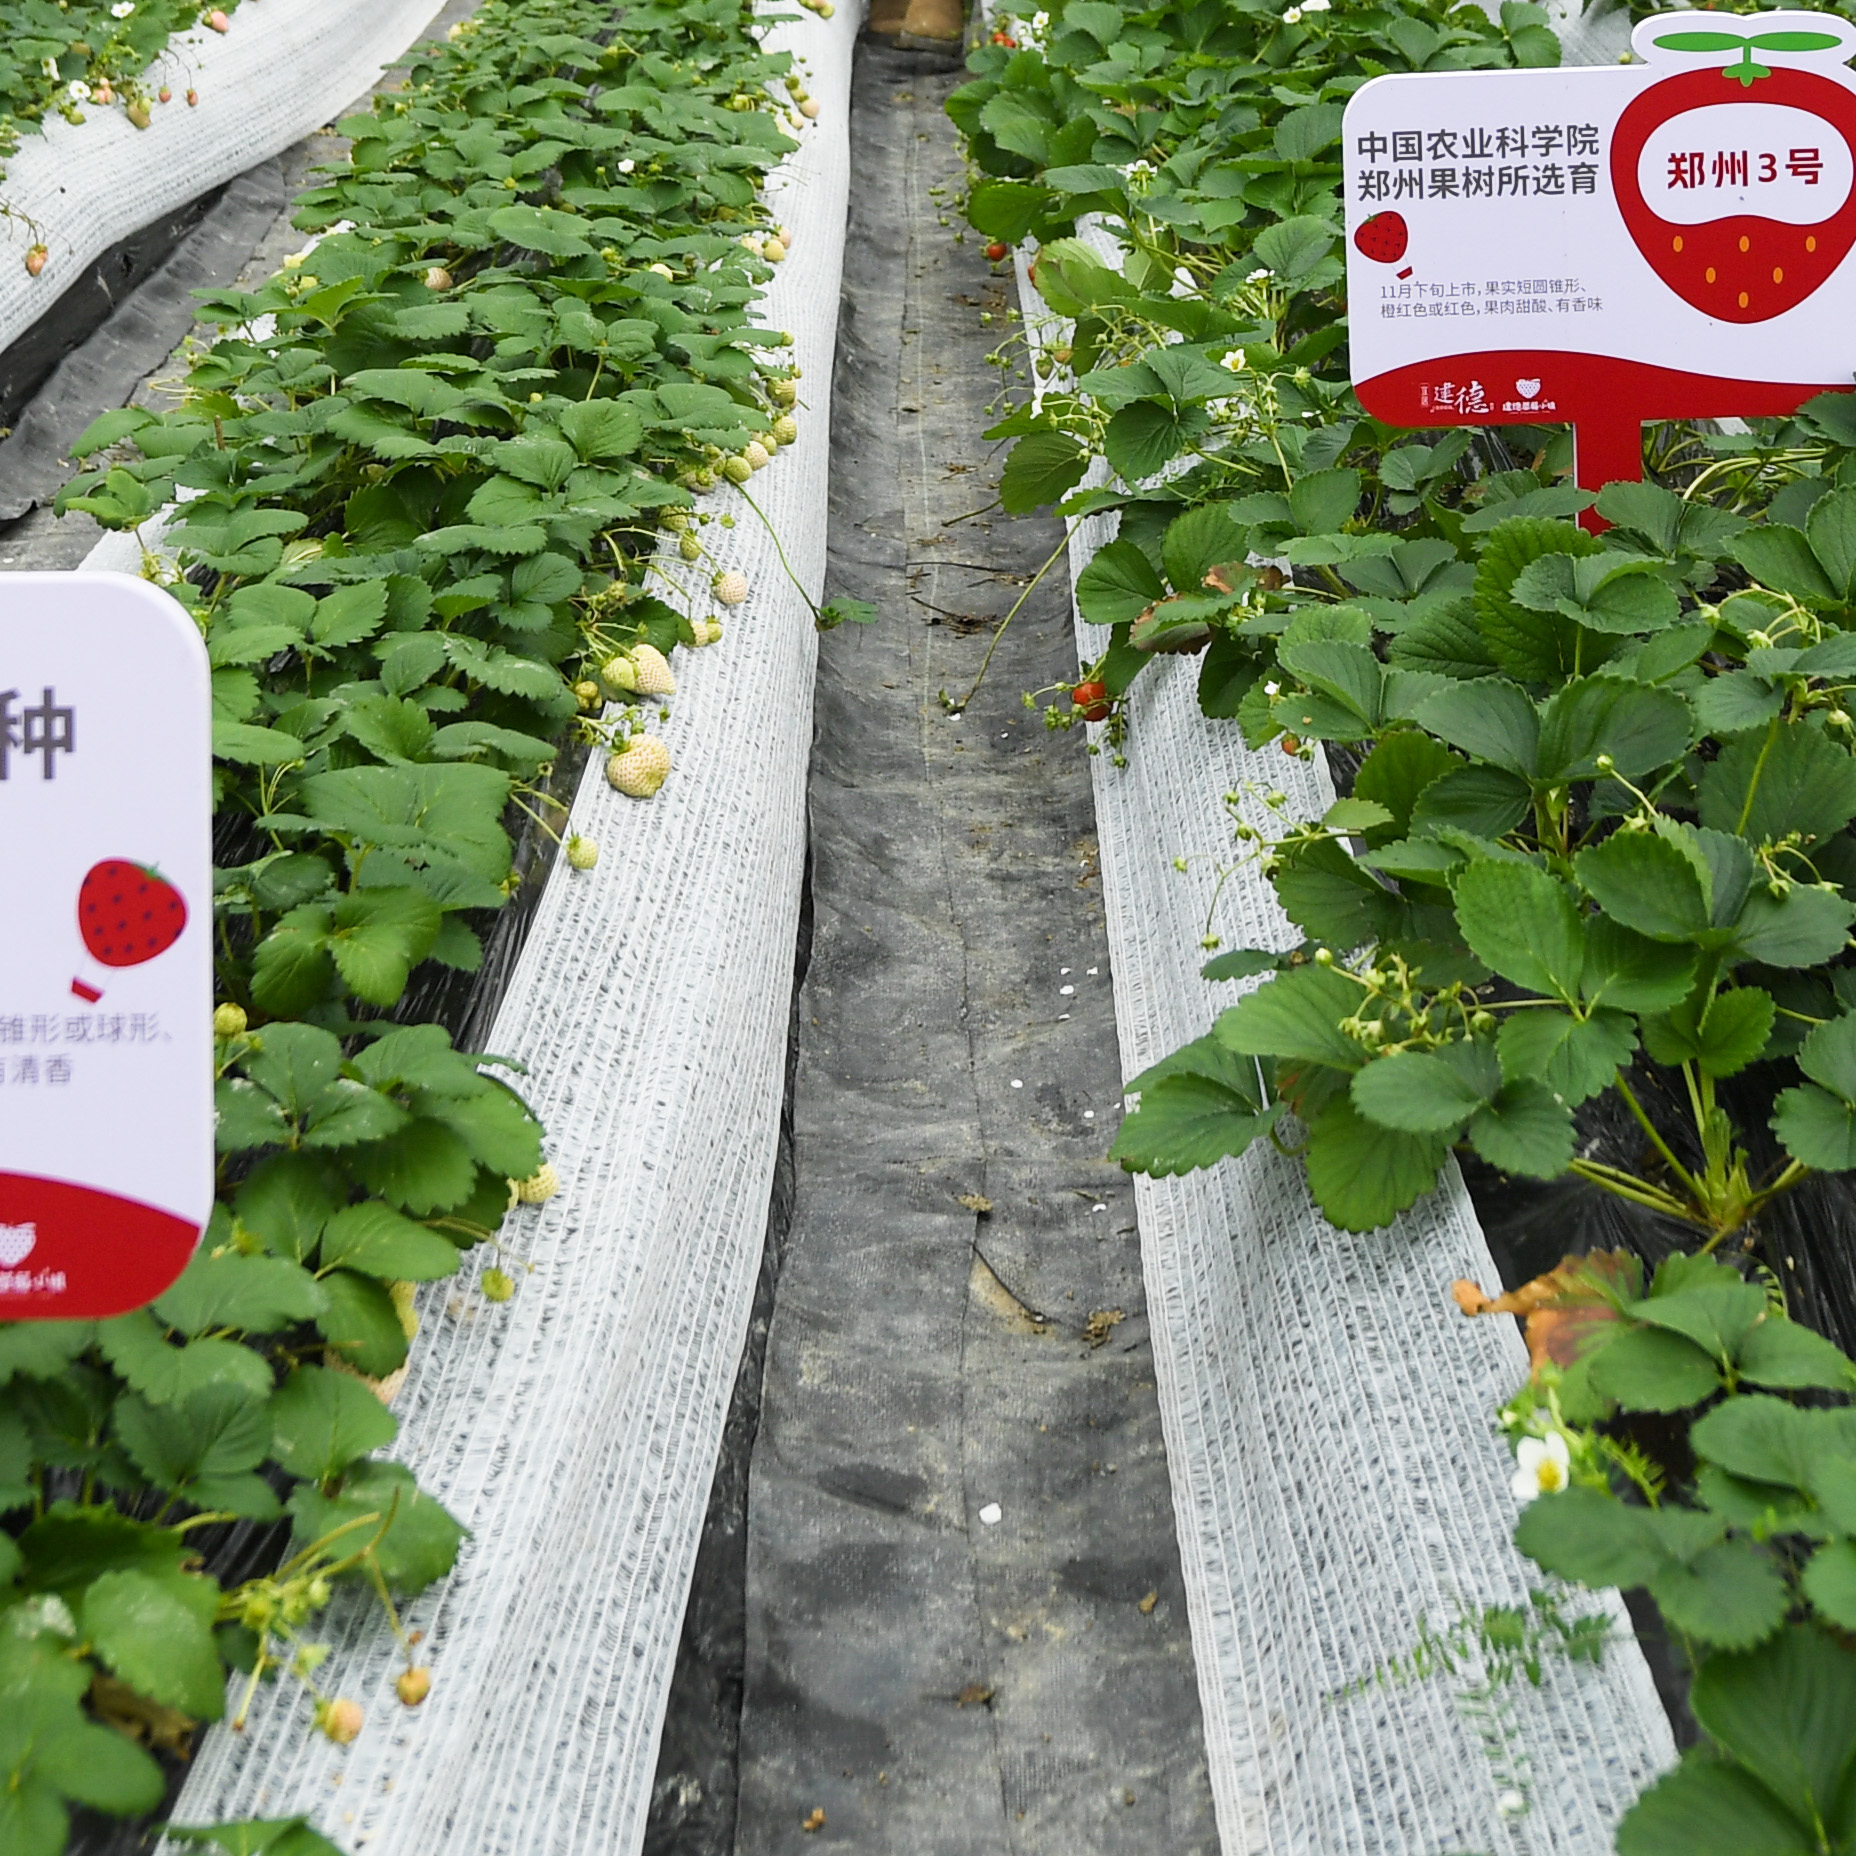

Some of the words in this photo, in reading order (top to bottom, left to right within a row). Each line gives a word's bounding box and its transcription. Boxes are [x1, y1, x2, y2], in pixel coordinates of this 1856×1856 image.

[1357, 123, 1600, 164] 中国农业科学院
[1357, 162, 1600, 202] 郑州果树所选育
[1666, 148, 1824, 190] 郑州3号
